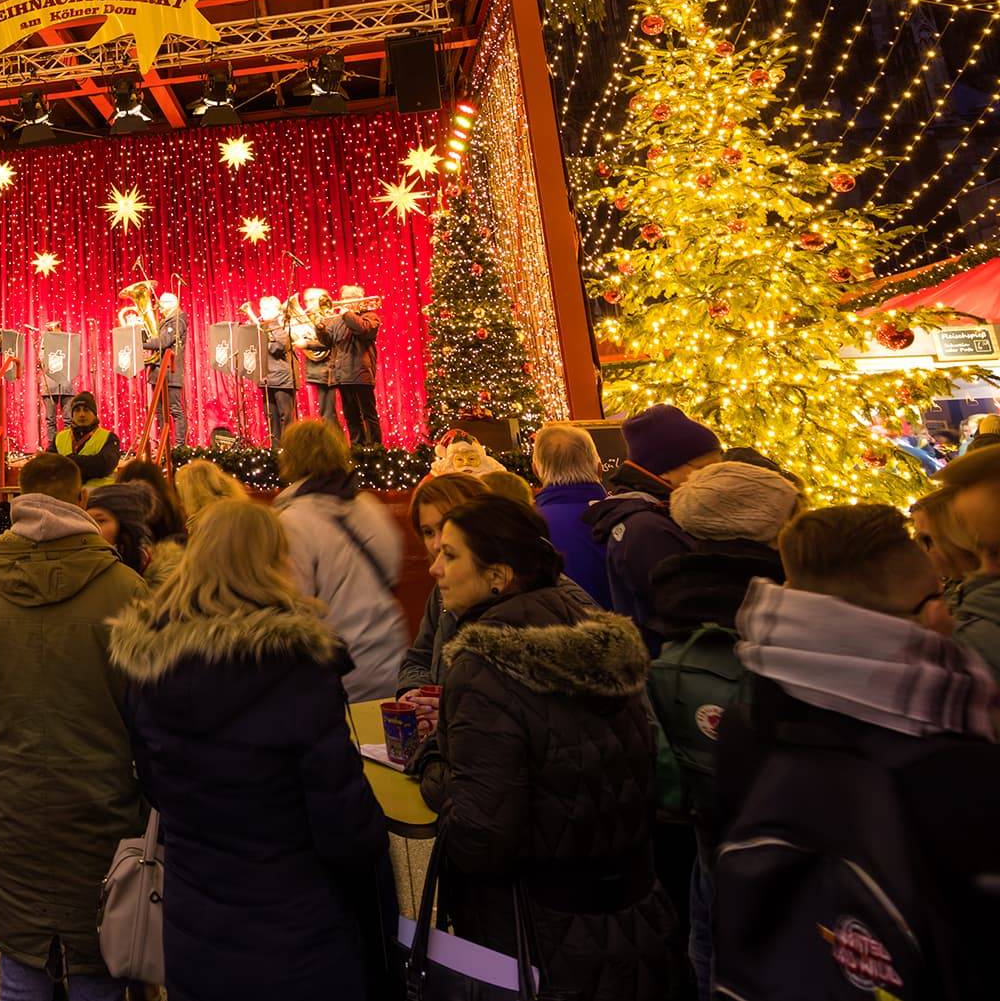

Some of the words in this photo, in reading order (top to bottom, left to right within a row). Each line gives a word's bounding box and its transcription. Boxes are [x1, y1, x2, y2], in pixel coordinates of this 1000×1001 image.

[20, 18, 41, 30] am
[50, 7, 99, 22] Kölner
[103, 4, 137, 16] Dom
